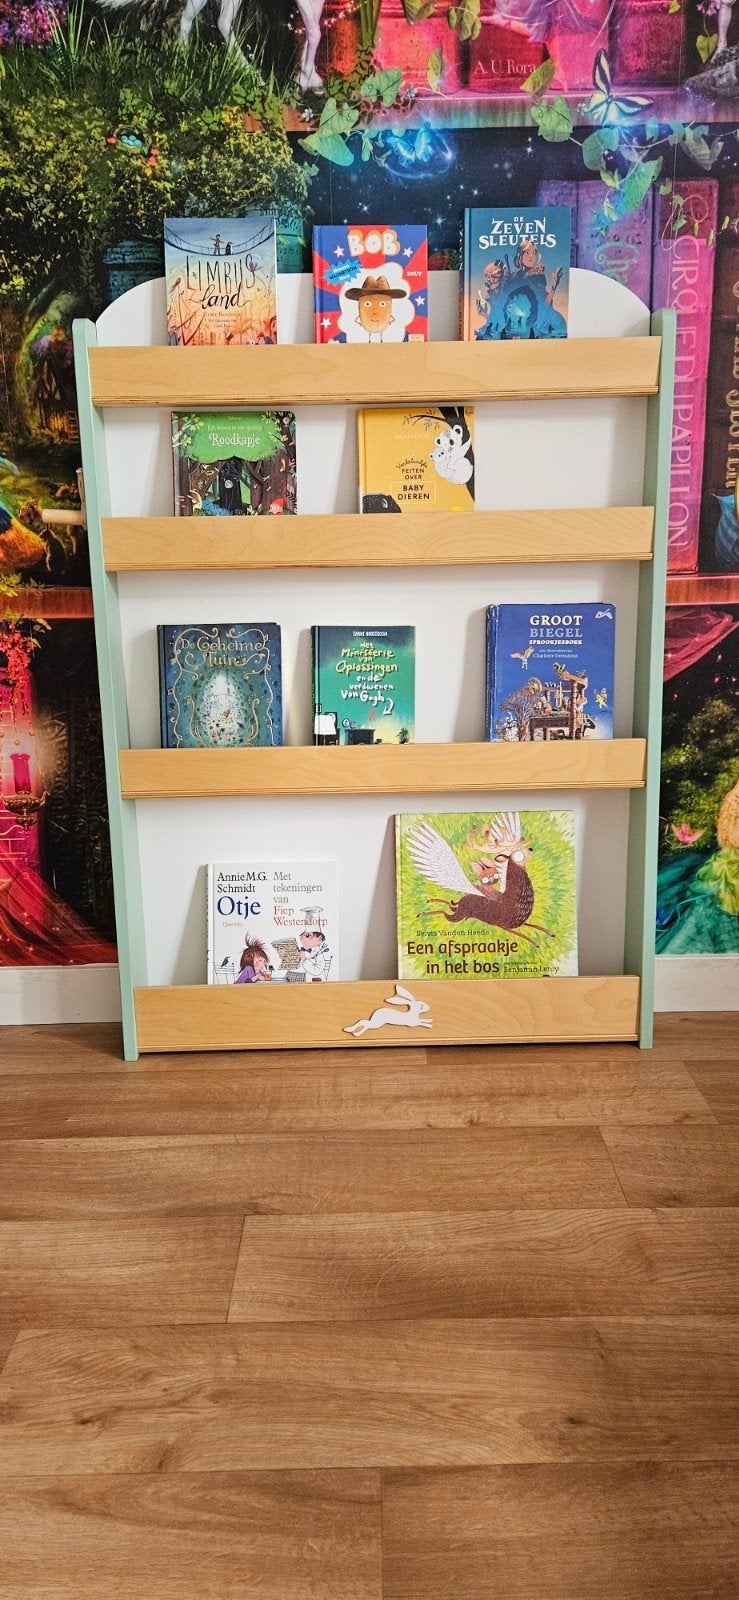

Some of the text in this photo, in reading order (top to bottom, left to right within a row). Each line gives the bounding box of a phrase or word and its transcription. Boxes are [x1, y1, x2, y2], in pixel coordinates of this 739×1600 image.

[474, 59, 536, 75] A. U. Rora
[490, 217, 547, 235] ZEVEN
[347, 229, 401, 257] BOB
[478, 233, 557, 250] SLEUTELS
[185, 253, 257, 294] LIMBUS
[199, 283, 247, 310] land
[208, 433, 261, 449] Roodkapje
[402, 484, 425, 492] BABY
[529, 615, 583, 626] GROOT
[529, 627, 583, 638] BIEGEL
[180, 636, 268, 652] De Geheime
[360, 641, 374, 650] Het
[205, 651, 238, 667] Tuin
[341, 648, 395, 660] Ministerie
[335, 660, 398, 677] Oplossingen
[367, 672, 381, 682] de
[349, 682, 394, 691] verdwenen
[340, 689, 385, 707] Van Gogh
[217, 871, 268, 882] Annie M.G.
[273, 871, 292, 881] Met
[216, 883, 256, 894] Schmidt
[273, 882, 323, 893] tekeningen
[273, 896, 289, 904] van
[216, 895, 261, 920] Otje
[273, 905, 295, 917] Fiep
[273, 917, 328, 928] Westendorp
[416, 929, 437, 938] Sylvia
[407, 939, 519, 958] Een afspraakje
[426, 959, 499, 974] in het bos
[503, 965, 560, 974] Benjamin Leroy
